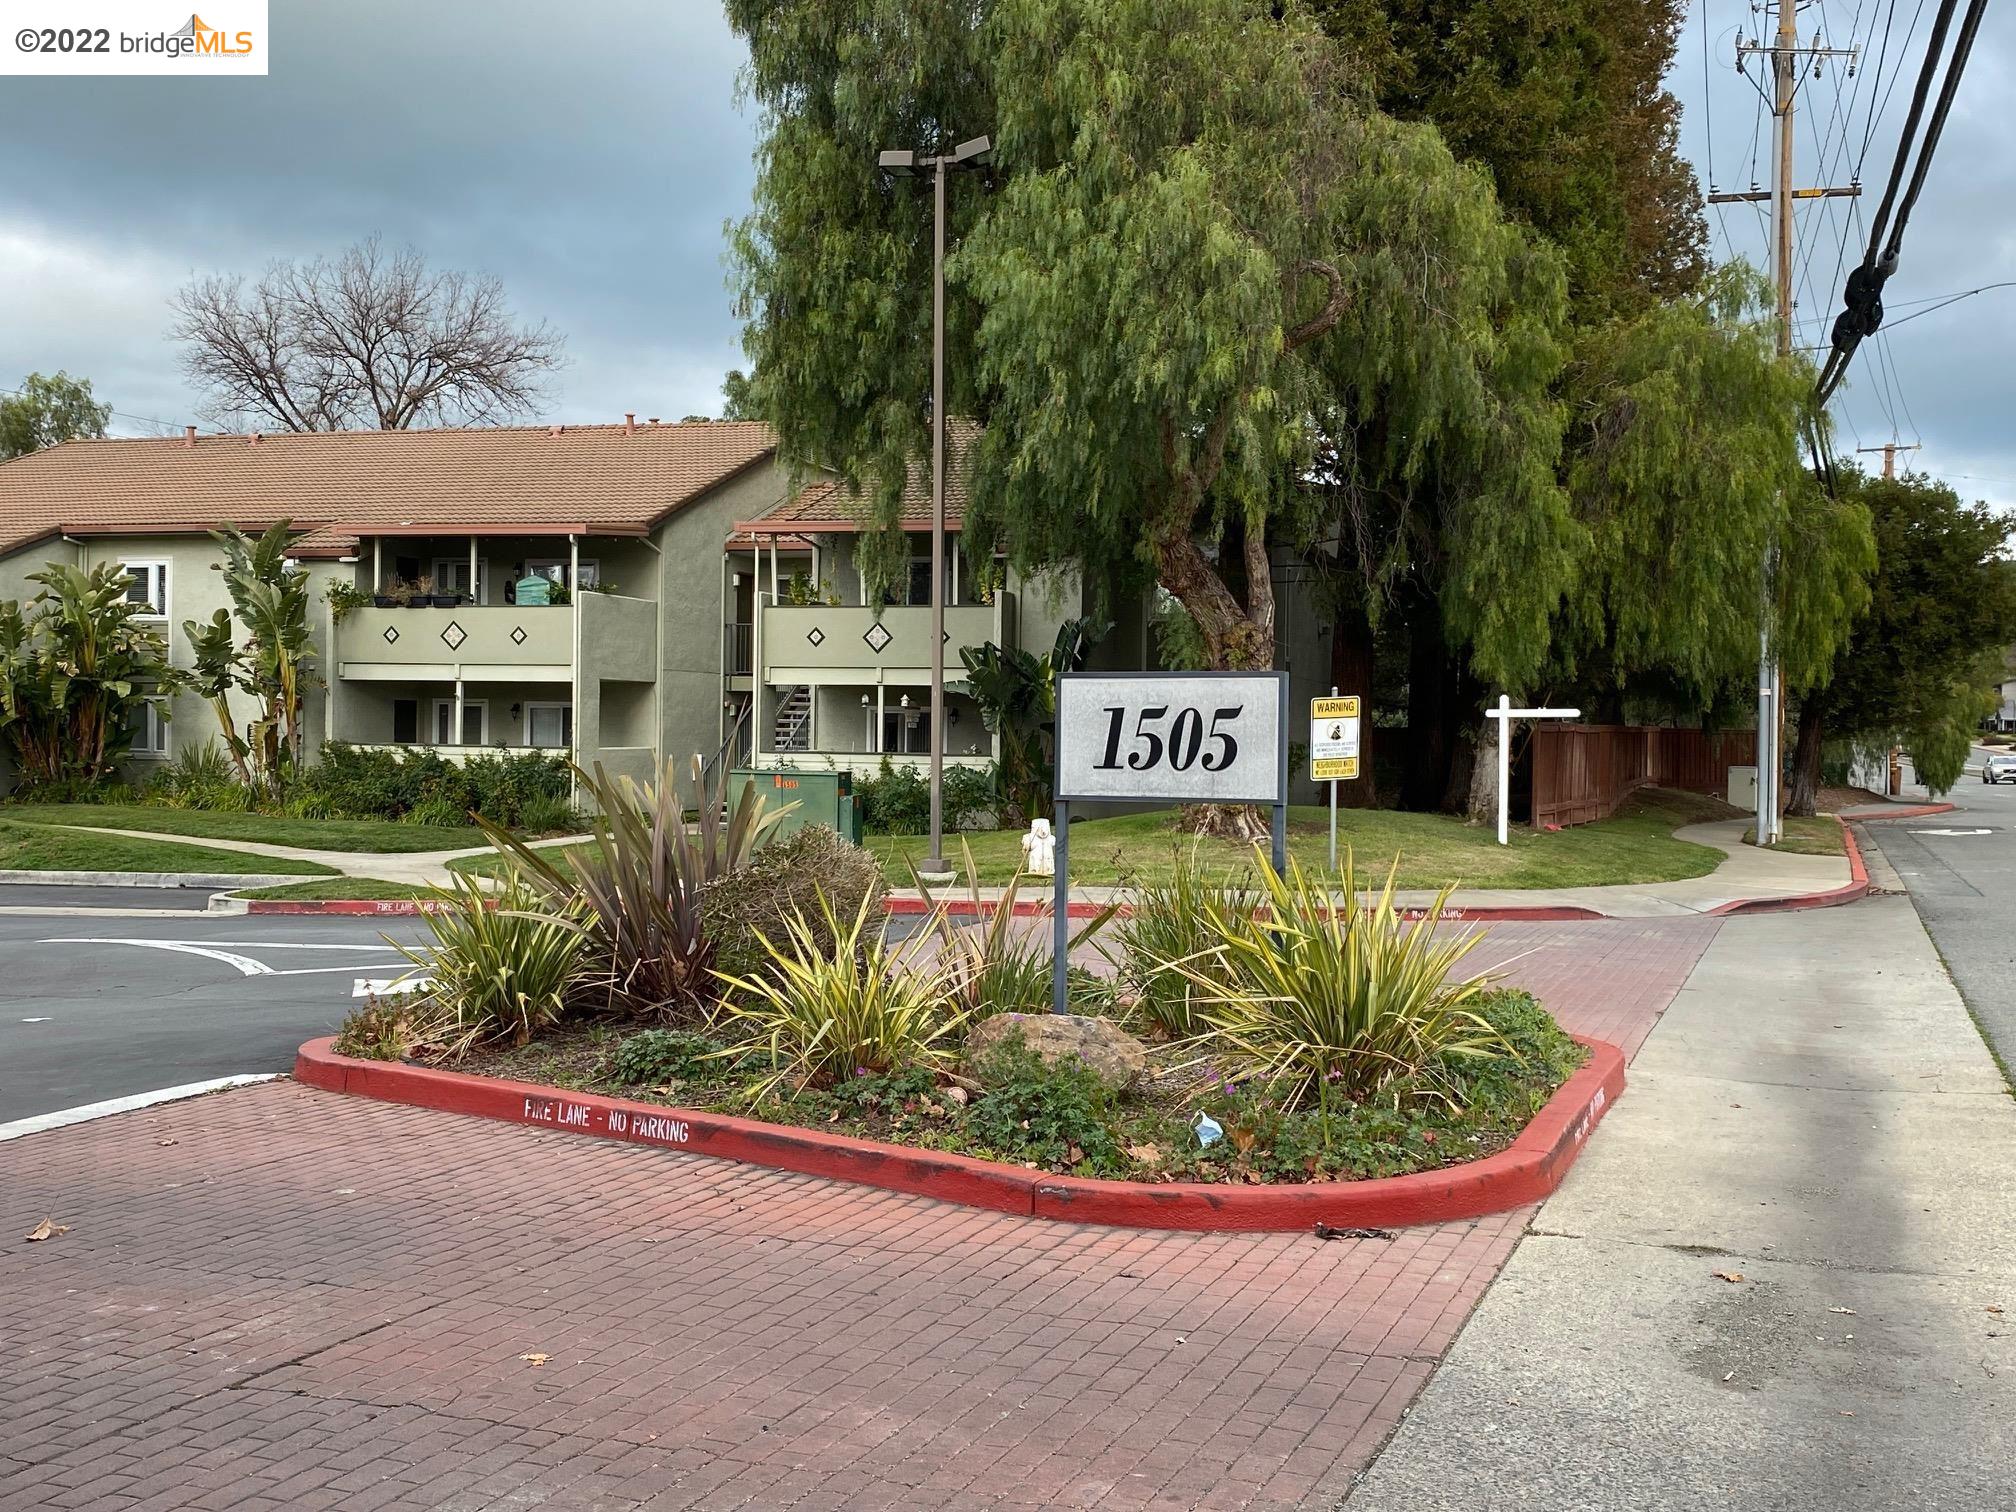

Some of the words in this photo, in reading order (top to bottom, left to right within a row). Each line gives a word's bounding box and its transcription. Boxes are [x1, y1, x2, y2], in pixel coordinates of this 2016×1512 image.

[1317, 702, 1354, 712] WARNING
[1092, 704, 1244, 772] 1505
[377, 902, 393, 912] FIRE
[396, 902, 414, 911] LANE
[524, 1099, 552, 1121] FIRE
[557, 1103, 591, 1127] LANE
[608, 1110, 627, 1132] NO
[632, 1116, 689, 1143] PARKING
